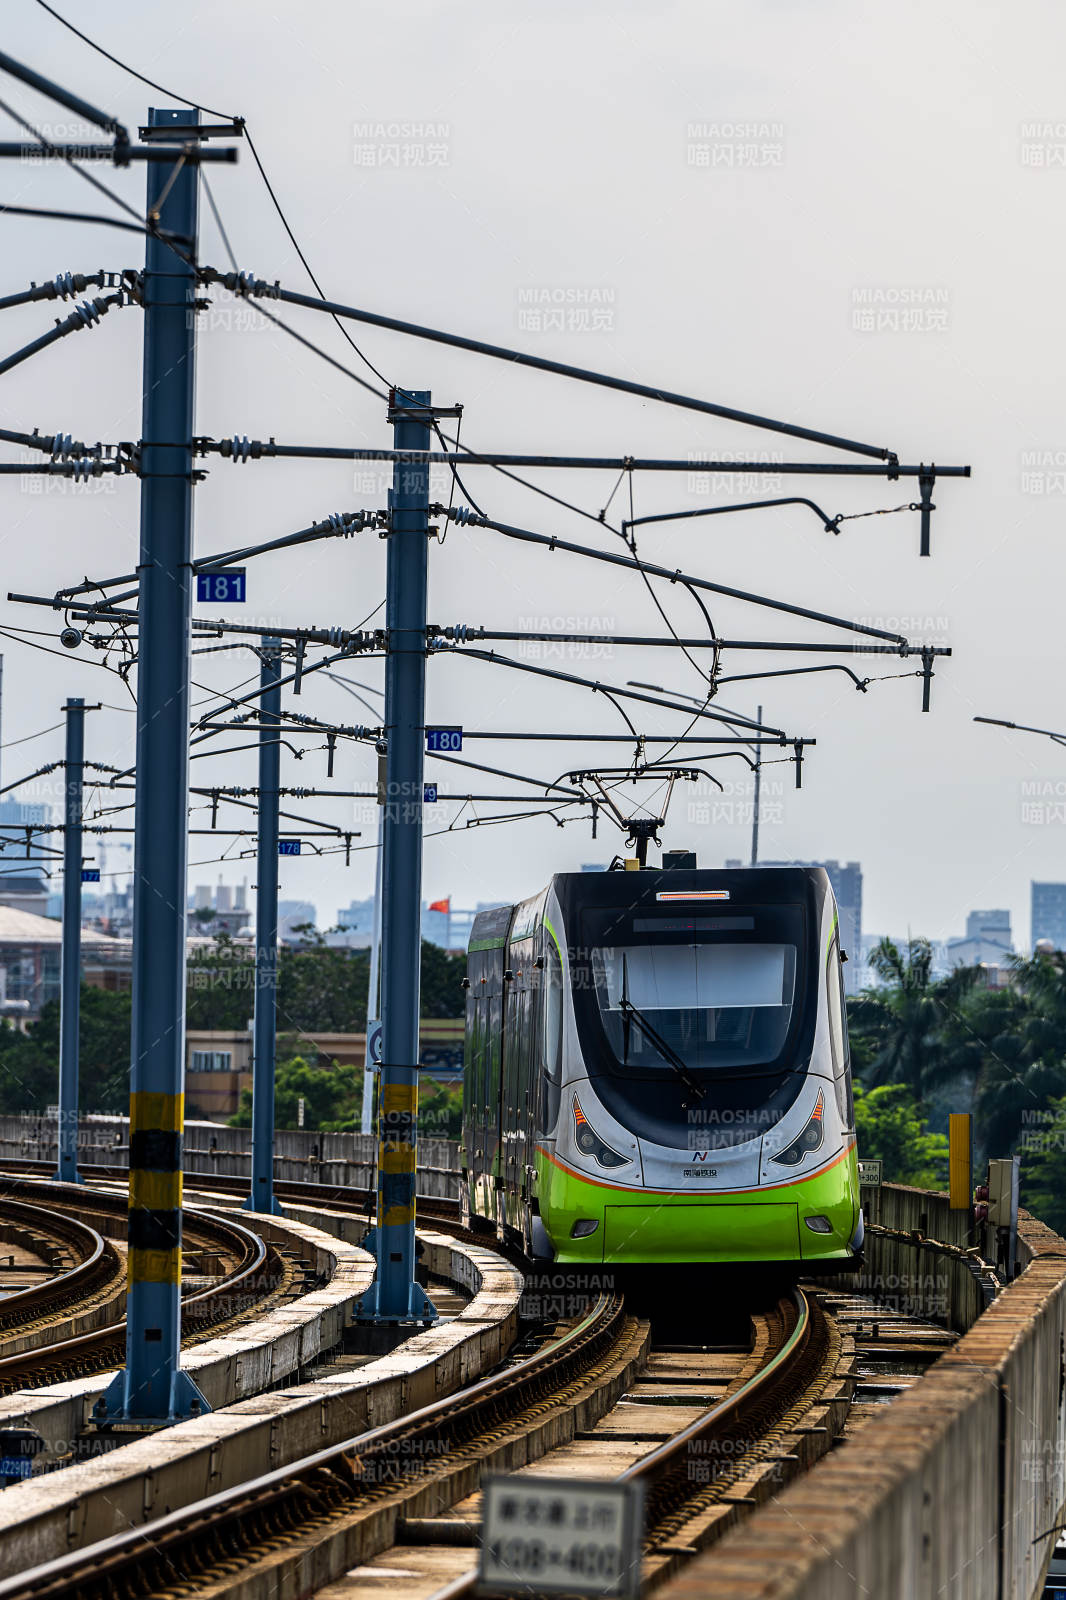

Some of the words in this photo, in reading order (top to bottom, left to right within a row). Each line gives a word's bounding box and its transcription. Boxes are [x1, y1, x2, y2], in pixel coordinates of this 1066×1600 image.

[201, 576, 241, 600] 181
[431, 732, 460, 750] 180
[281, 842, 300, 854] 178
[84, 872, 98, 880] 177
